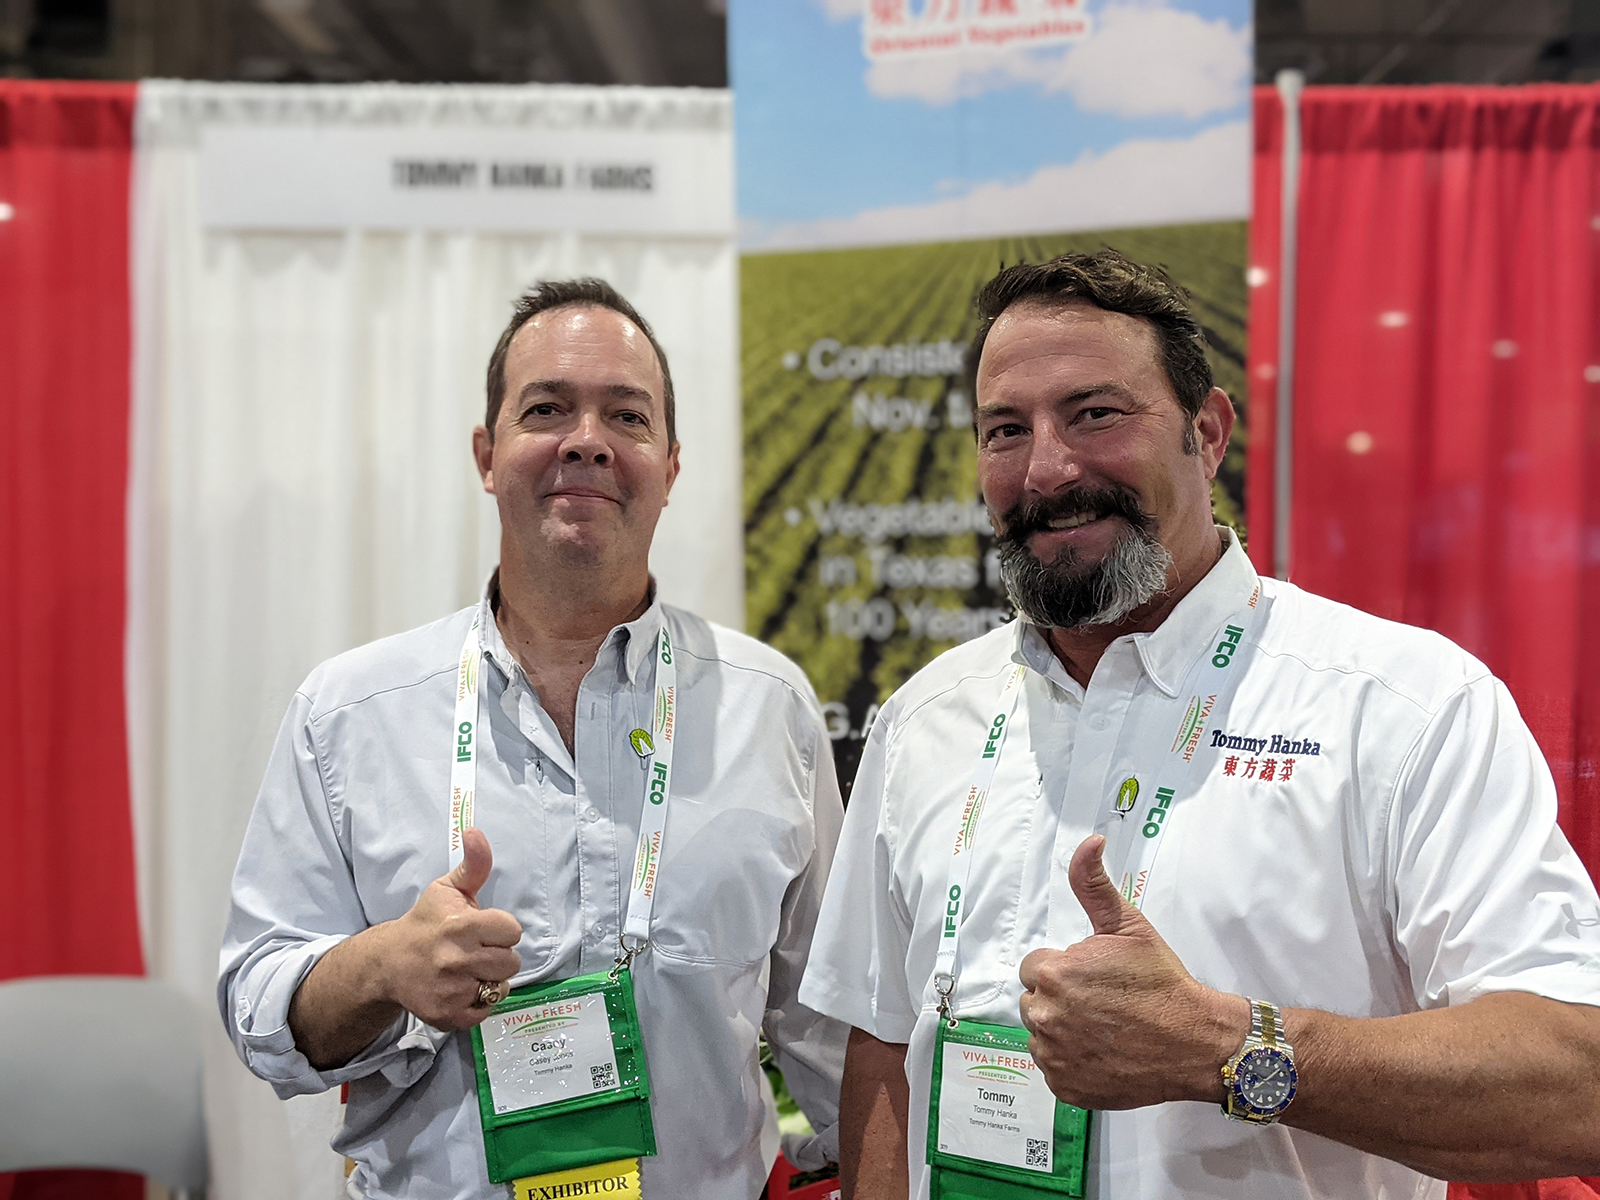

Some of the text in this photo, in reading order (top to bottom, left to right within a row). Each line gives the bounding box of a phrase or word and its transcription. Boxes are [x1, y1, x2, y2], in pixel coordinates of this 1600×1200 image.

[866, 547, 980, 590] Texas
[826, 598, 897, 642] 100
[661, 626, 673, 665] IFCO
[1212, 624, 1244, 669] IFCO
[664, 686, 674, 741] VIVA FRESH
[1199, 694, 1218, 719] VIVA
[456, 721, 473, 763] IFCO
[982, 713, 1006, 758] IFCO
[1182, 726, 1204, 762] FRESH
[1210, 729, 1321, 756] Tommy Hanka
[649, 761, 668, 805] IFCO
[452, 786, 462, 851] VIVA FRESH
[953, 828, 965, 856] VIVA
[962, 786, 978, 820] FRESH
[1142, 786, 1176, 839] IFCO
[644, 830, 662, 899] VIVA FRESH
[1132, 870, 1148, 898] VIVA
[944, 884, 961, 938] IFCO
[503, 1002, 582, 1027] VIVA FRESH
[962, 1051, 1036, 1071] VIVA FRESH
[973, 1105, 1017, 1119] Tommy Hanka
[977, 1088, 1015, 1106] Tommy
[969, 1117, 987, 1128] Tommy
[987, 1121, 1004, 1130] Hanka
[527, 1176, 629, 1200] EXHIBITOR
